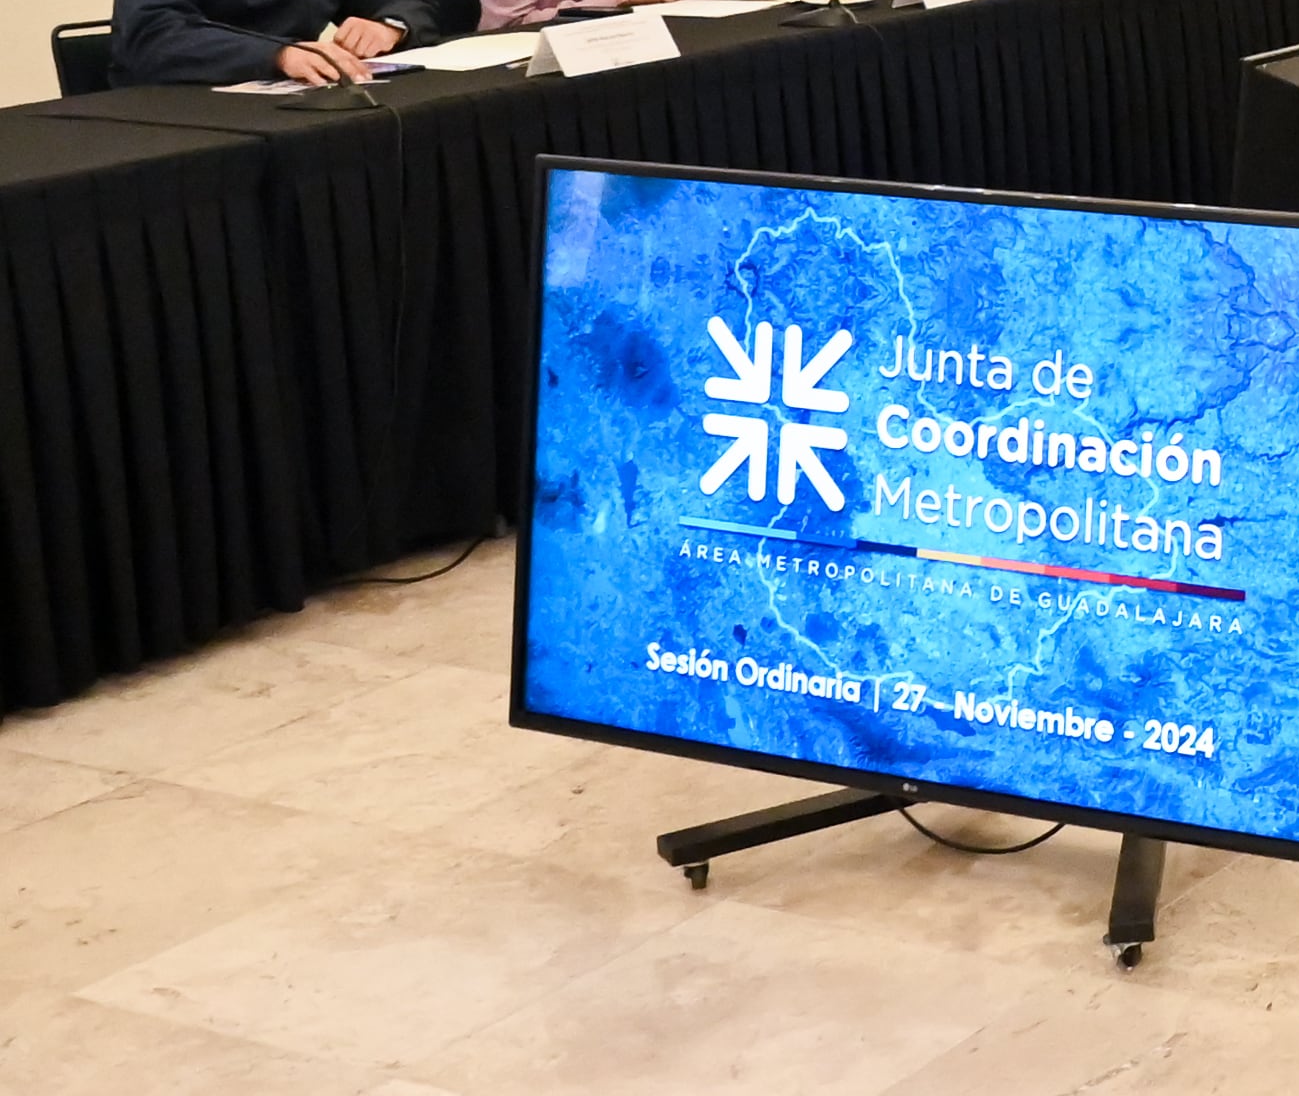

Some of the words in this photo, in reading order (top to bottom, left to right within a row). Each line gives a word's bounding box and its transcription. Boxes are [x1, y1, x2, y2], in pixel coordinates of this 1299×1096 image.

[878, 334, 1014, 391] Junta
[1032, 348, 1094, 399] de
[876, 403, 1222, 487] Coordinación
[874, 473, 1224, 561] Metropolitana
[679, 538, 742, 565] ÁREA
[757, 553, 973, 598] METROPOLITANA
[989, 585, 1023, 606] DE
[1038, 591, 1243, 635] GUADALAJARA
[645, 641, 729, 682] Sesión
[735, 656, 862, 704] Ordinaria
[892, 681, 927, 713] 27
[953, 690, 1115, 743] Noviembre
[1143, 719, 1216, 759] 2024
